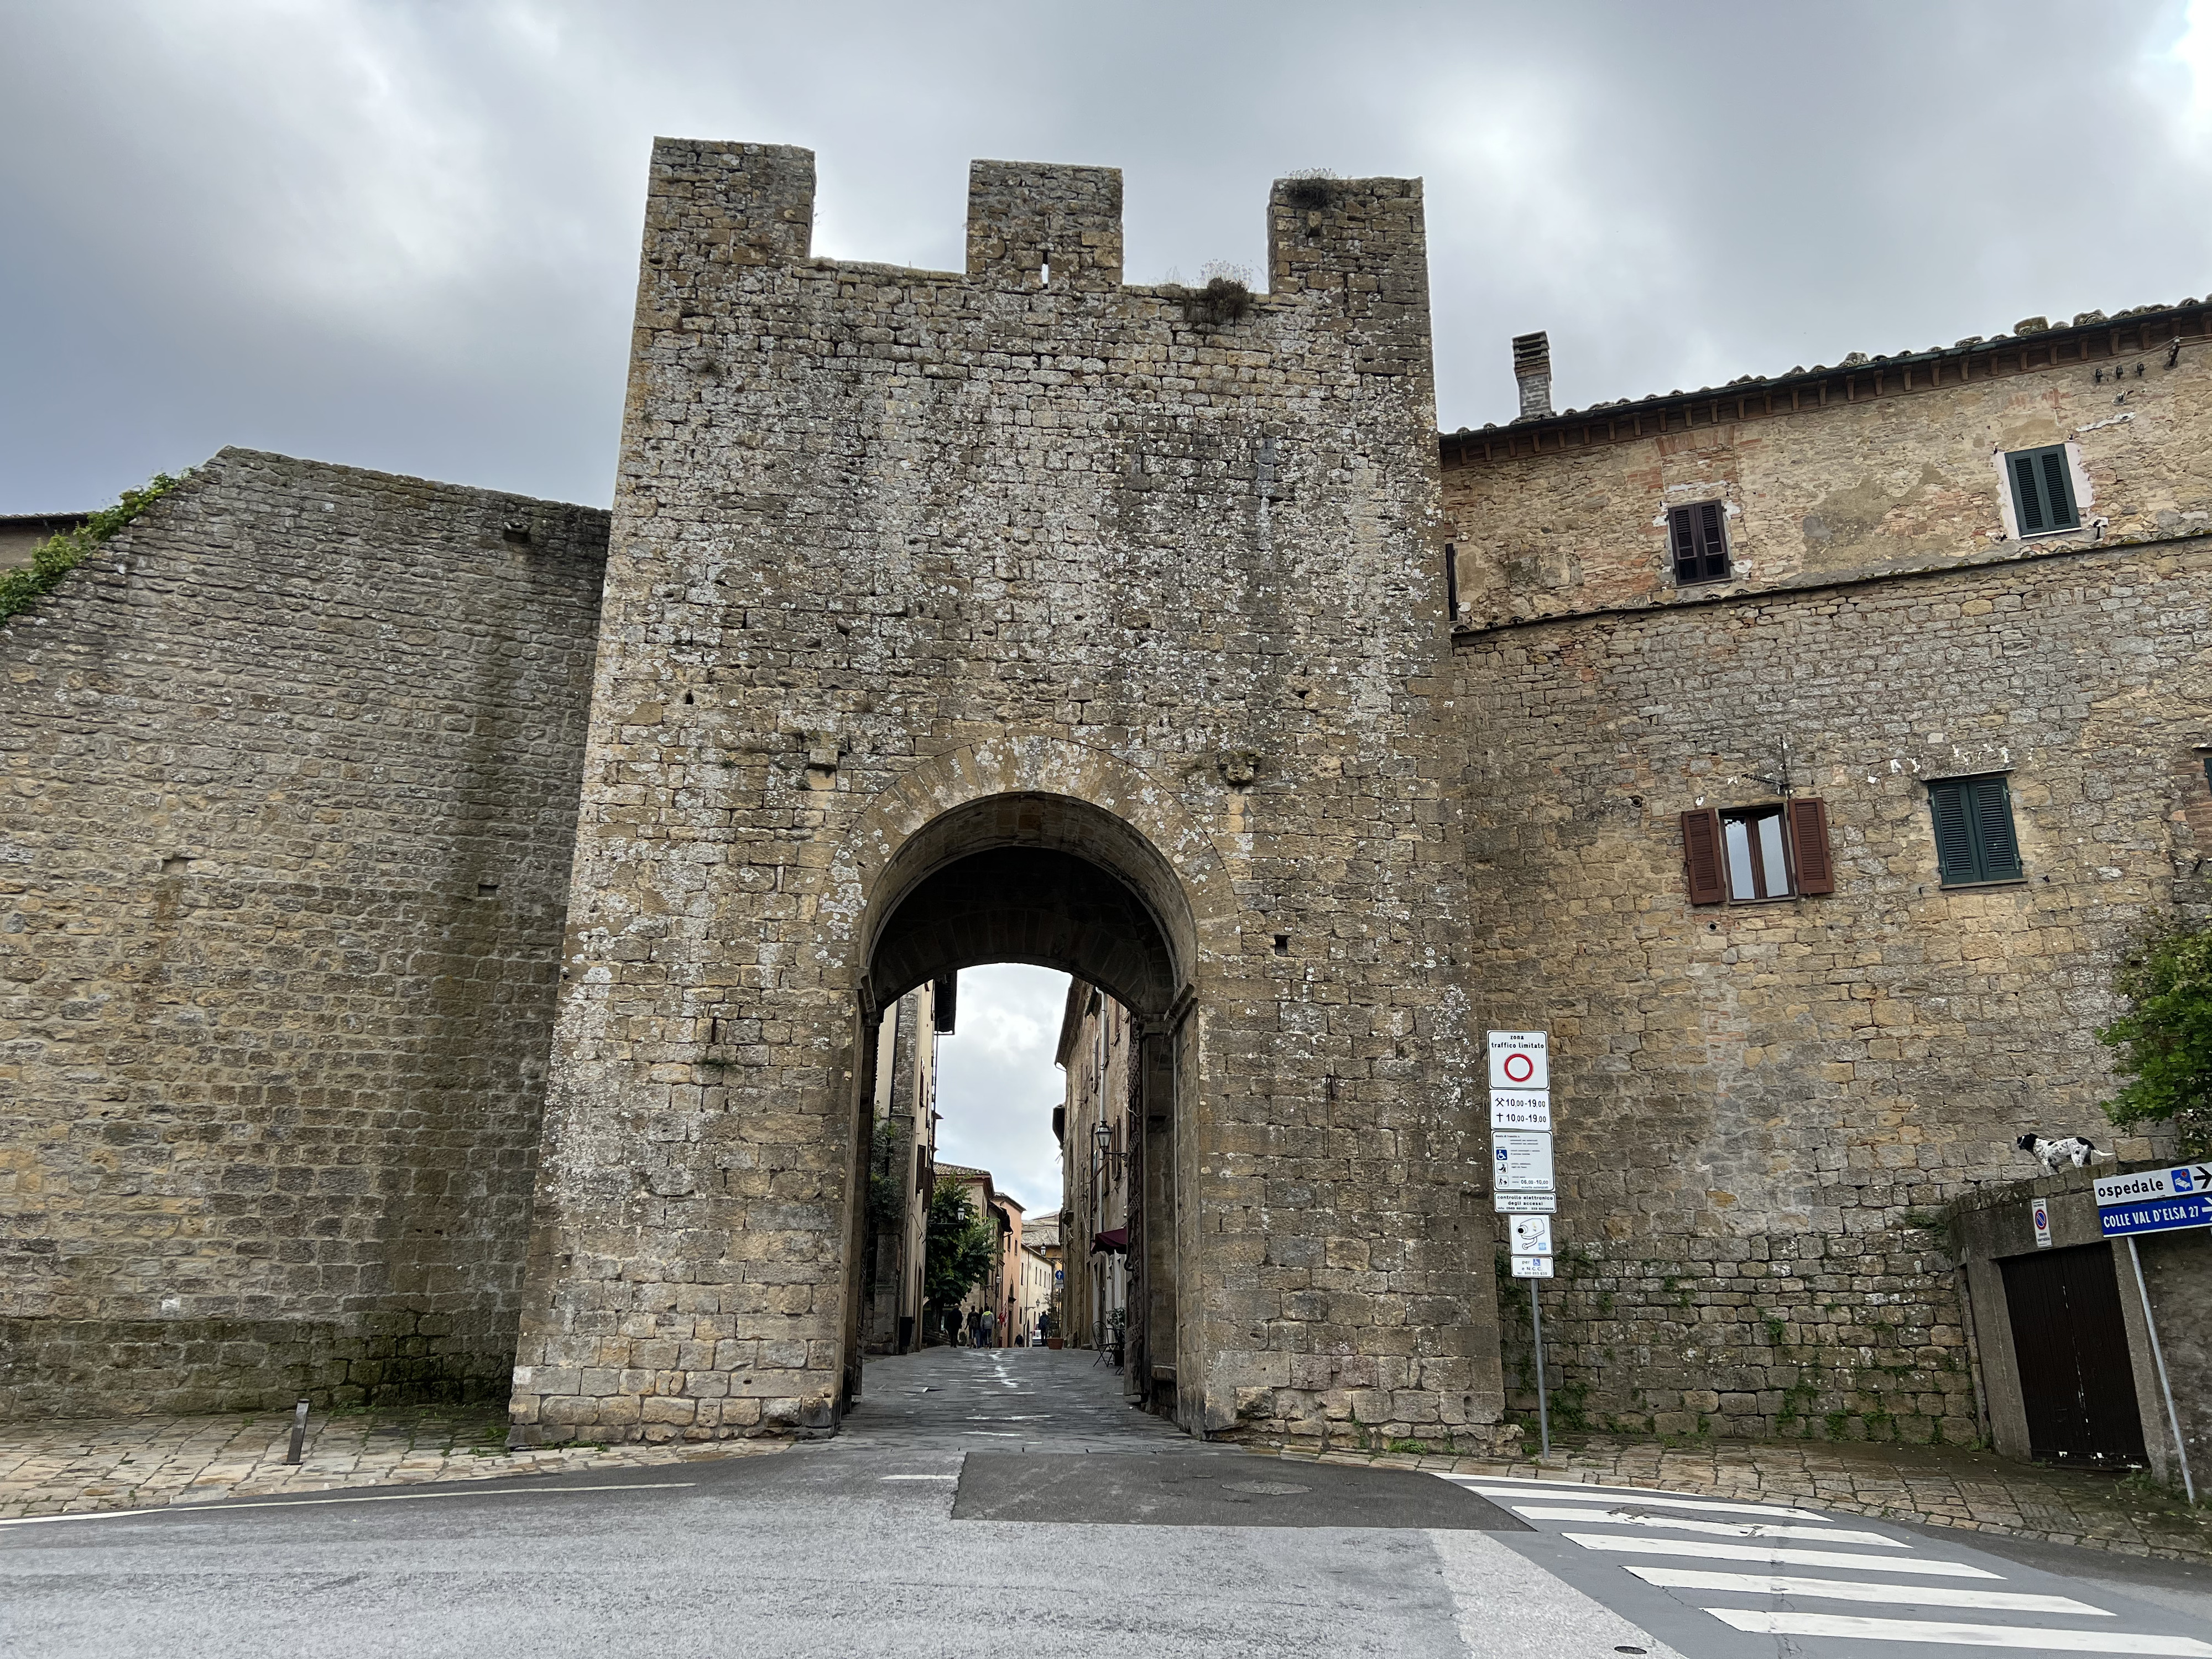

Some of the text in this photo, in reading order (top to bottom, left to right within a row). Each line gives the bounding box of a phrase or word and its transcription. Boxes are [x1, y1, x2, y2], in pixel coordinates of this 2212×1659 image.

[2098, 1178, 2164, 1198] ospedale
[2104, 1206, 2199, 1228] COLLE VAL D'ELSA 27
